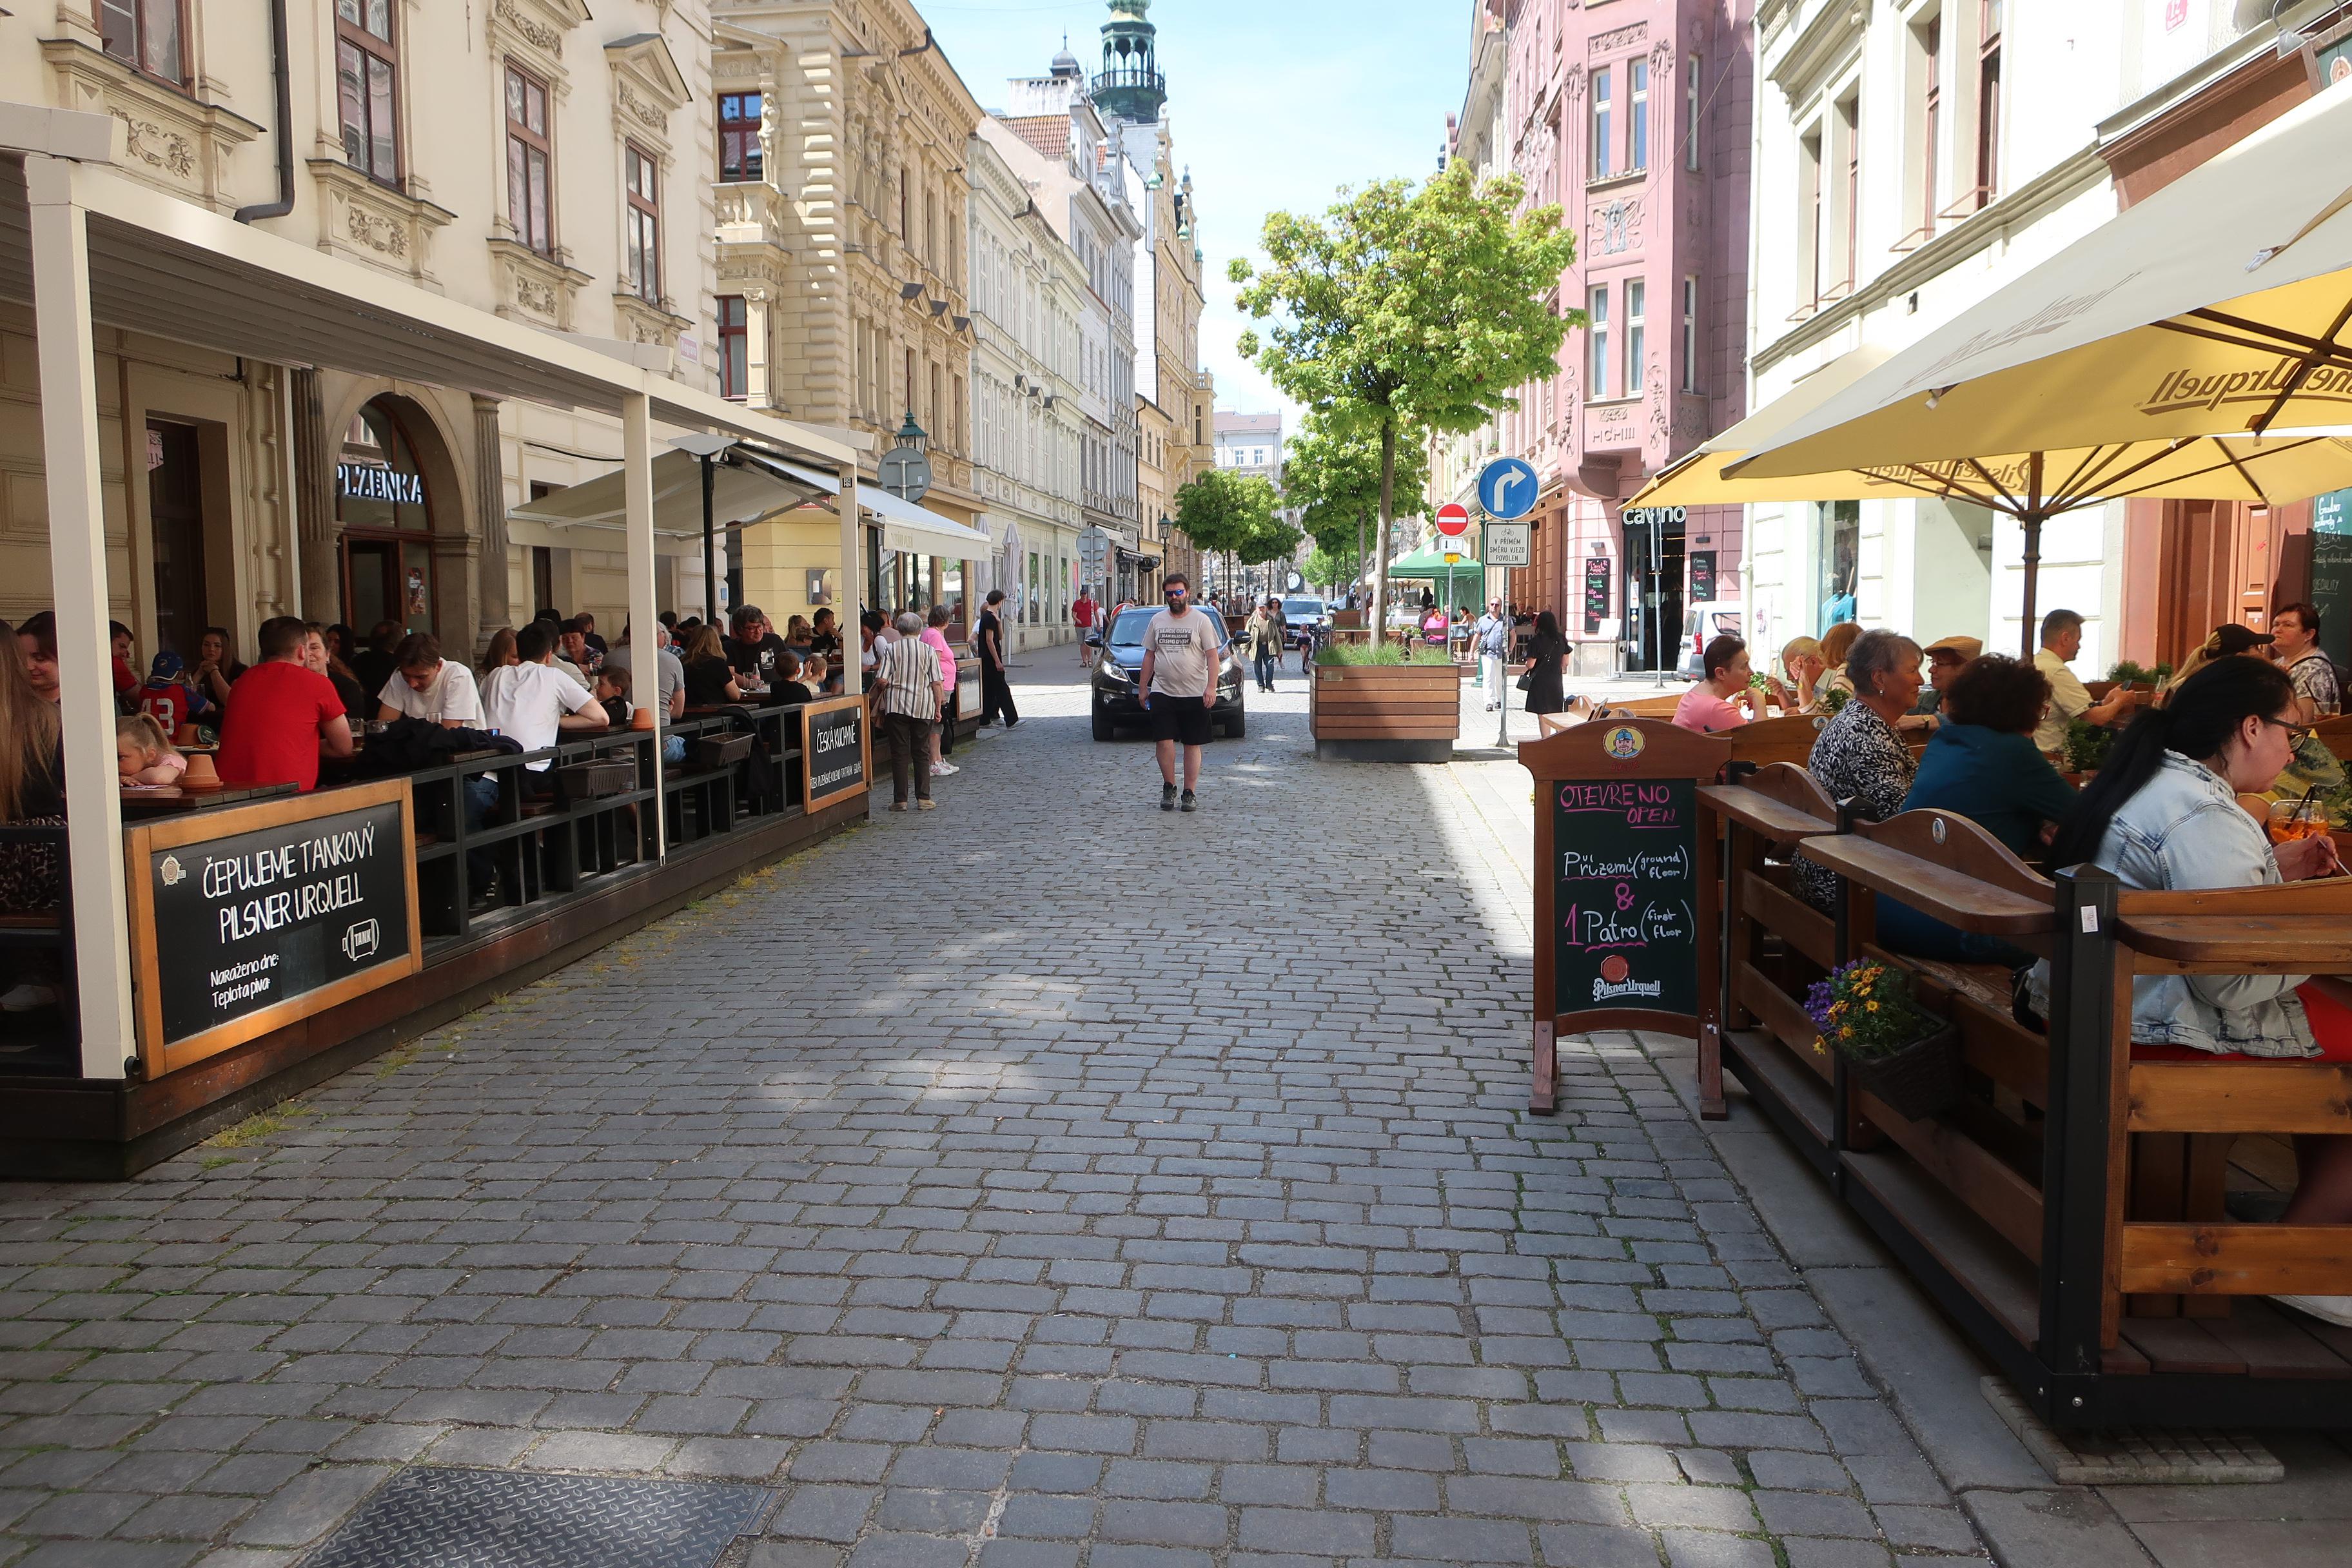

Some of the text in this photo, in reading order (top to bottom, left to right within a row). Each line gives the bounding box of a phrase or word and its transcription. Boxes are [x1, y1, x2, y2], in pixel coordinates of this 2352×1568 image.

[816, 726, 834, 754] ČESKÁ
[1560, 781, 1670, 807] OTEVŘENO
[1627, 807, 1676, 823] OPEN
[202, 821, 375, 899] ČEPUJEME TANKOVÝ
[219, 872, 364, 944] PILSNER URQUELL
[1615, 883, 1635, 910] &
[355, 929, 371, 946] TANK
[1565, 903, 1583, 945] 1
[1583, 911, 1638, 943] Patro
[210, 953, 279, 987] Naraženo dne:
[212, 977, 270, 1010] Teplota piva:
[1592, 978, 1661, 1002] Pilsner Urquell
